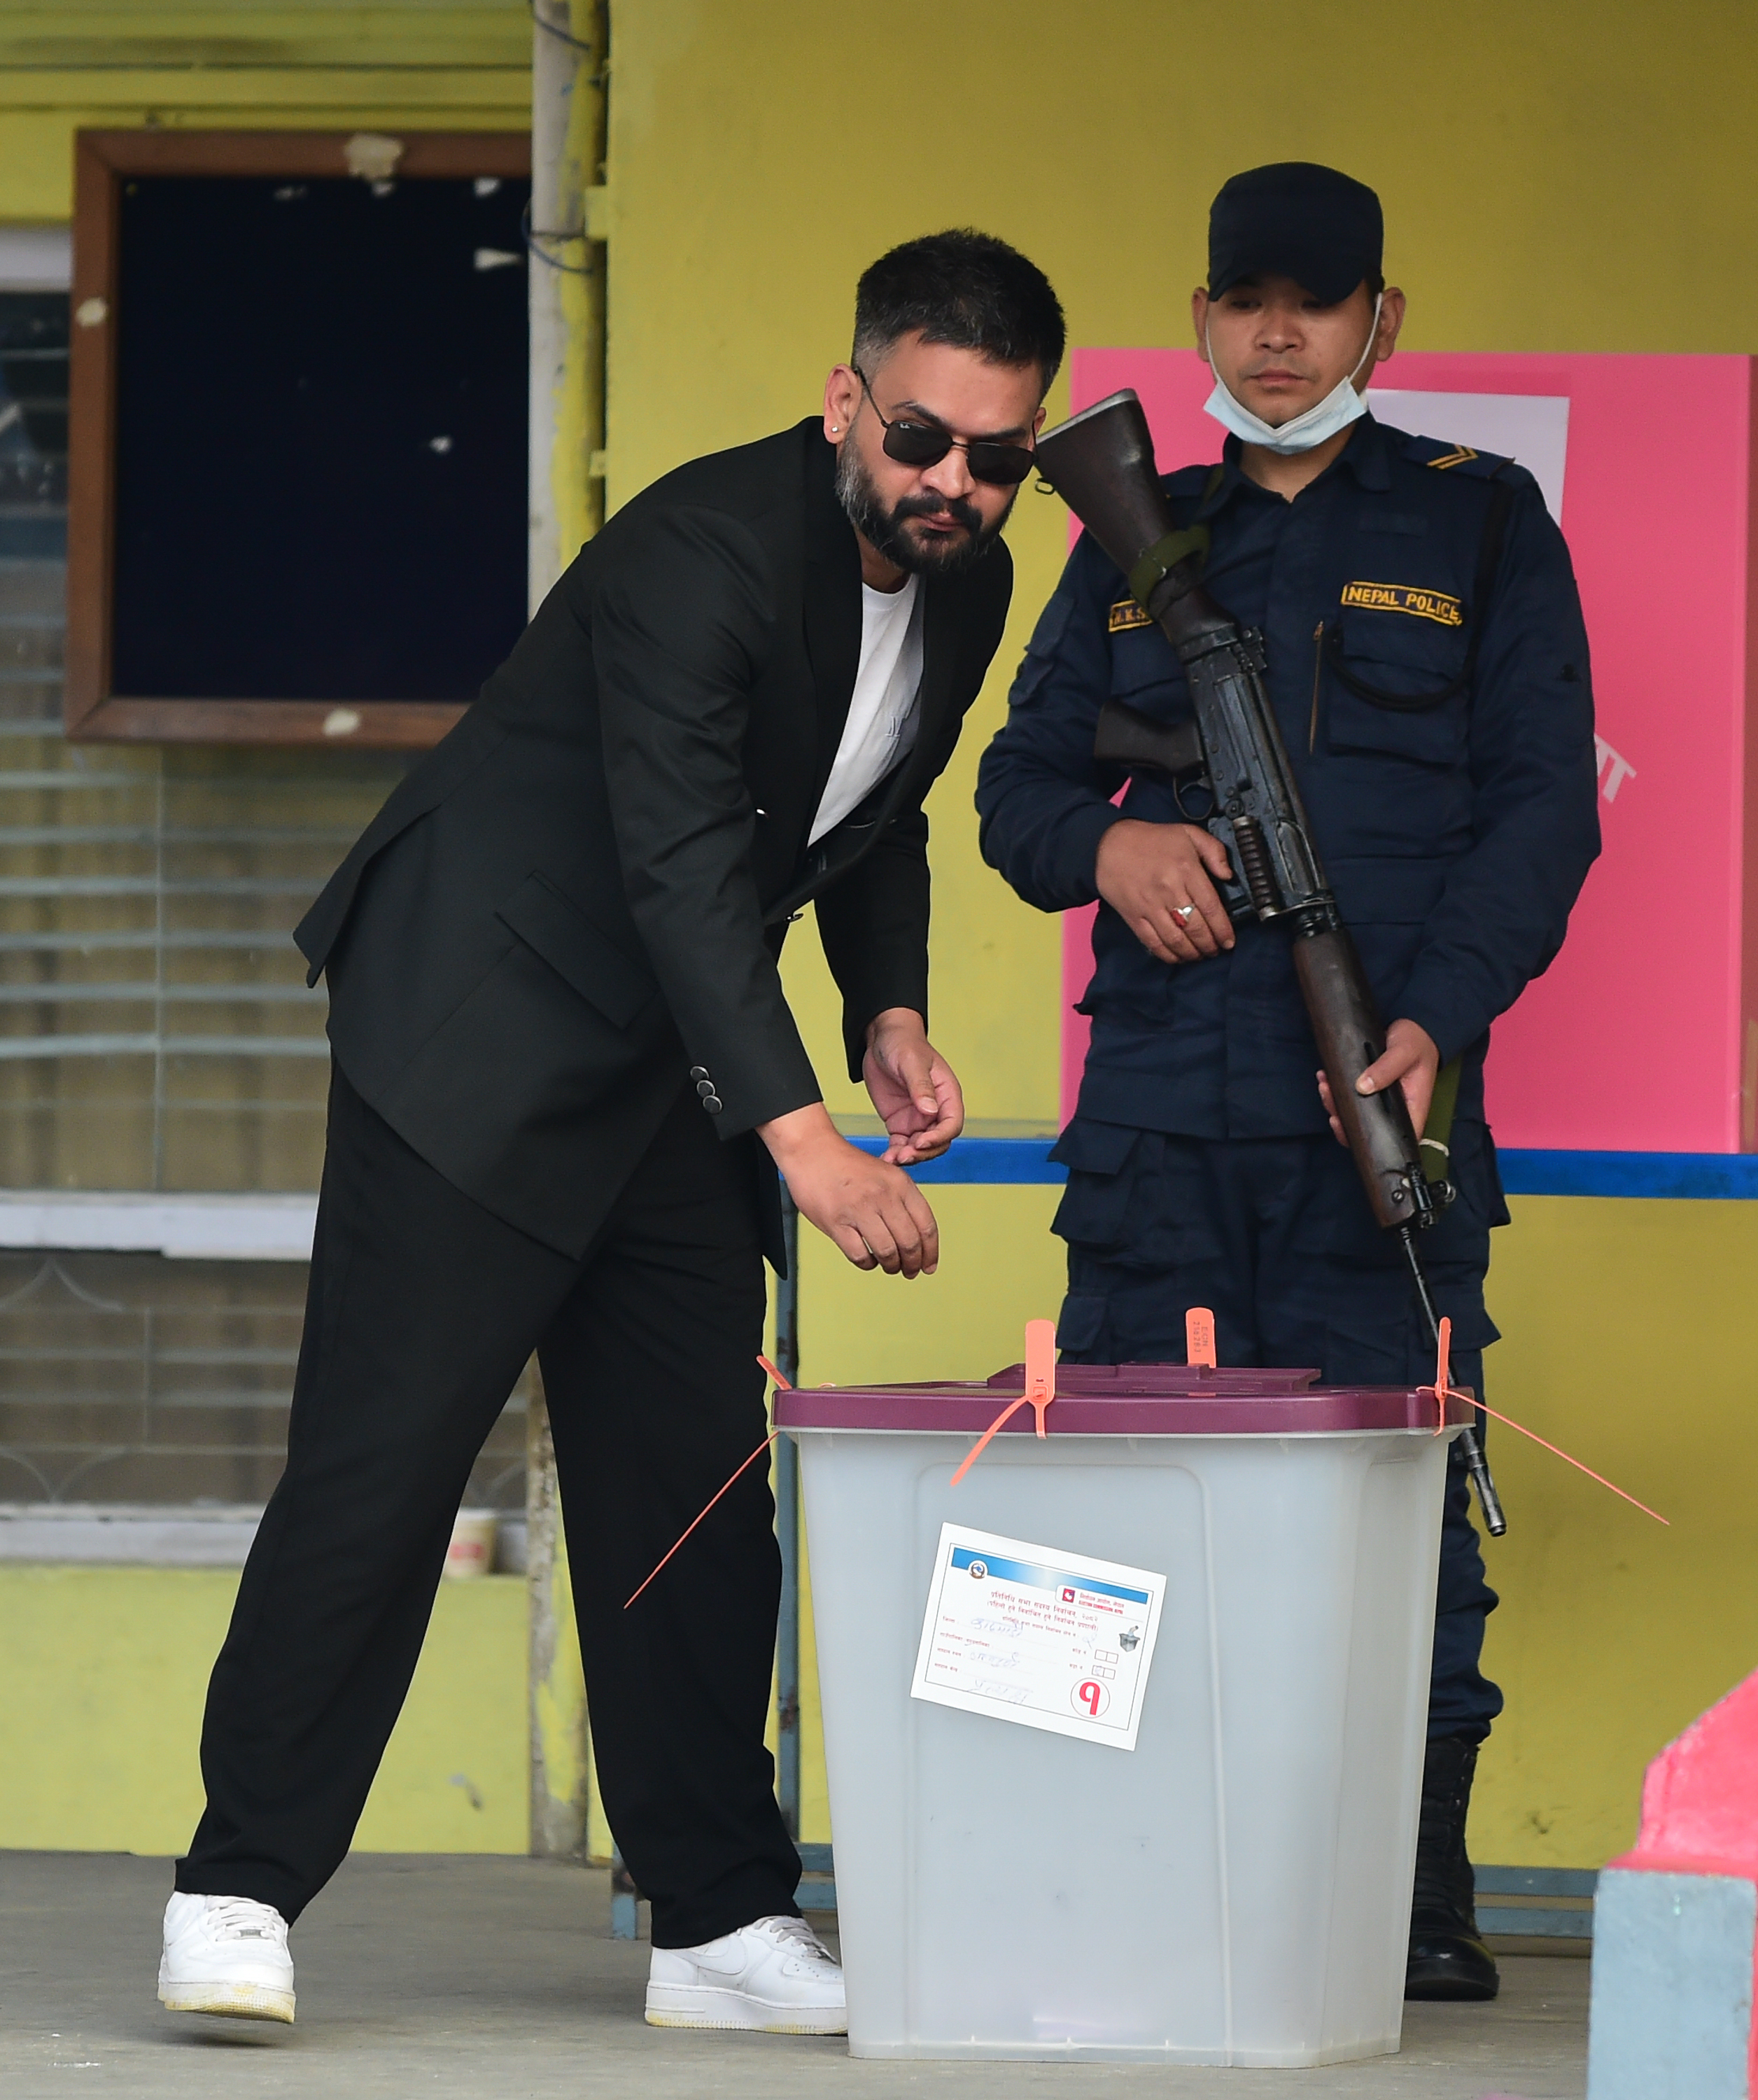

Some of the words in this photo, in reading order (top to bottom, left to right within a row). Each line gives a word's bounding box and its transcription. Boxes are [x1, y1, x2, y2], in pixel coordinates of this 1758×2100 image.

[1348, 587, 1399, 605] NEPAL
[1405, 593, 1460, 620] POLICE
[1018, 1597, 1030, 1606] सभा
[1079, 1681, 1101, 1716] १
